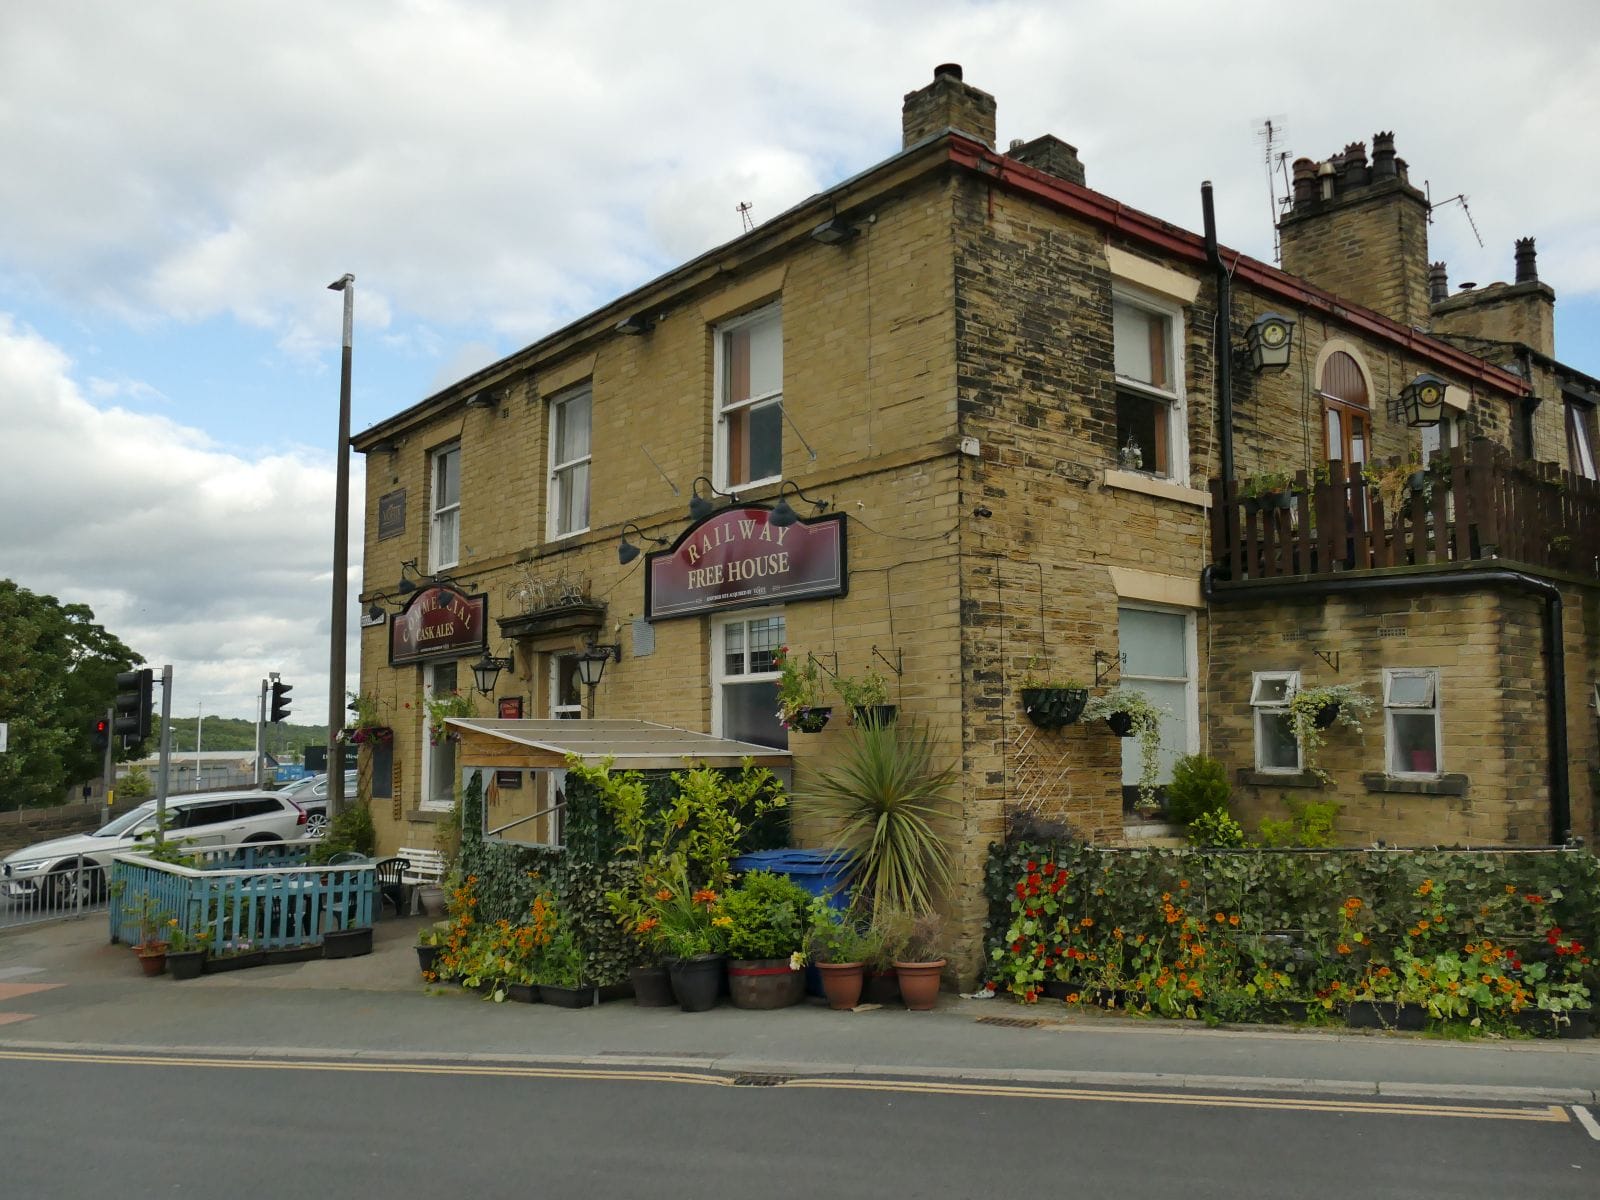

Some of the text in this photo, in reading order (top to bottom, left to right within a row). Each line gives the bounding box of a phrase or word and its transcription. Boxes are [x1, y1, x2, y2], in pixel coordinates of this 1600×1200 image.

[688, 519, 790, 565] RAILWAY
[687, 551, 790, 590] FREE HOUSE
[402, 596, 471, 643] COMMECIAL
[416, 621, 454, 641] CASK ALES
